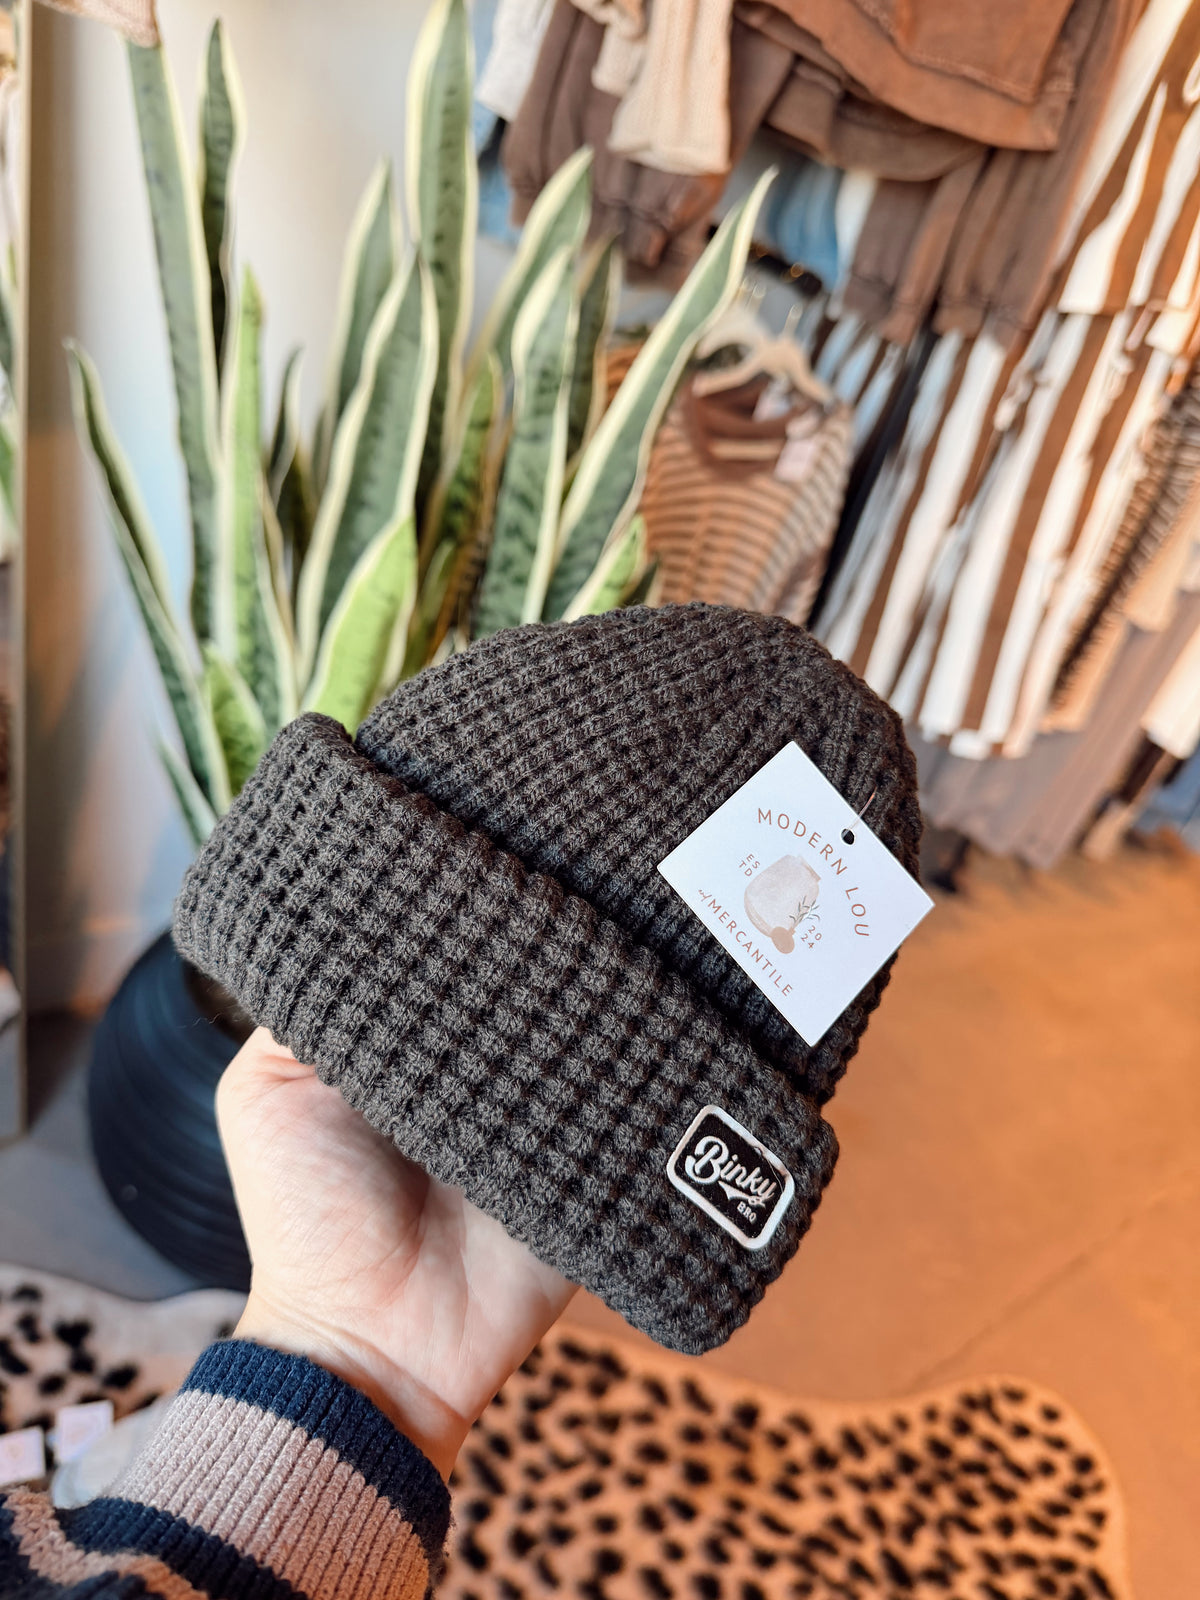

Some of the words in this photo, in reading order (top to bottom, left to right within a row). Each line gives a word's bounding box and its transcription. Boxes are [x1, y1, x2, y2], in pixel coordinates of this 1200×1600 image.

[757, 807, 848, 876] MODERN
[845, 886, 870, 937] LOU
[707, 898, 793, 997] MERCANTILE
[808, 925, 822, 941] 20
[685, 1135, 777, 1208] Binky
[737, 1201, 757, 1223] BRO
